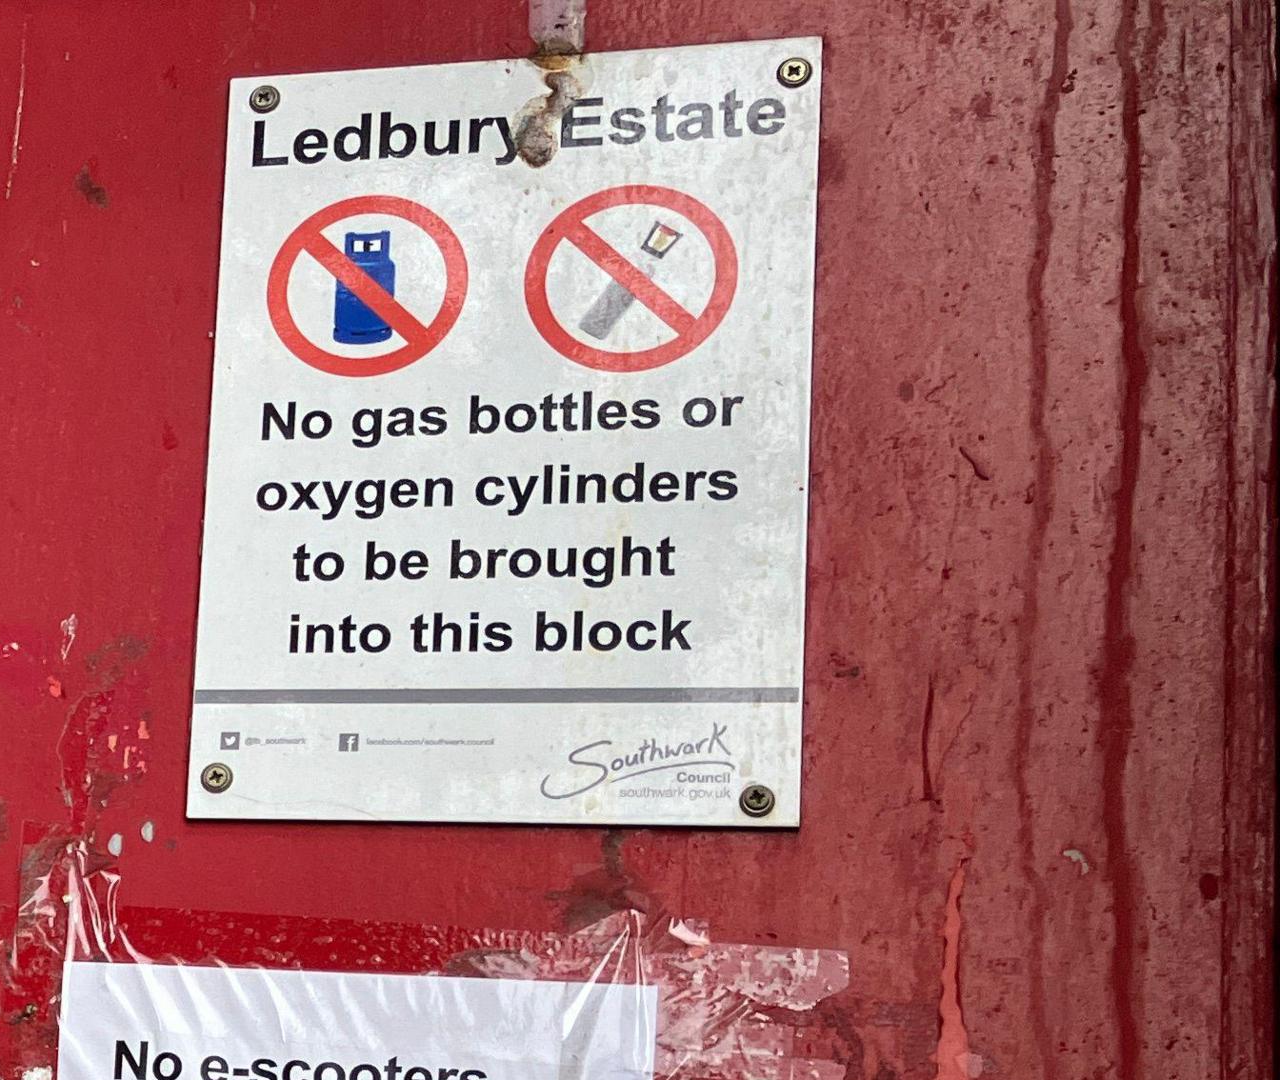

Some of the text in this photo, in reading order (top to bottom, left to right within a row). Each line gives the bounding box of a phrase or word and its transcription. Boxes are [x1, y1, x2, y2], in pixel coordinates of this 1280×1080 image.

[251, 94, 786, 168] Ledbury Estate
[261, 391, 744, 448] No gas bottles or
[256, 462, 738, 520] oxygen cylinders
[292, 536, 676, 588] to be brought
[289, 609, 692, 653] into this block
[540, 722, 732, 799] Southwark
[676, 772, 731, 784] Council
[619, 787, 732, 800] southwark.gov.uk
